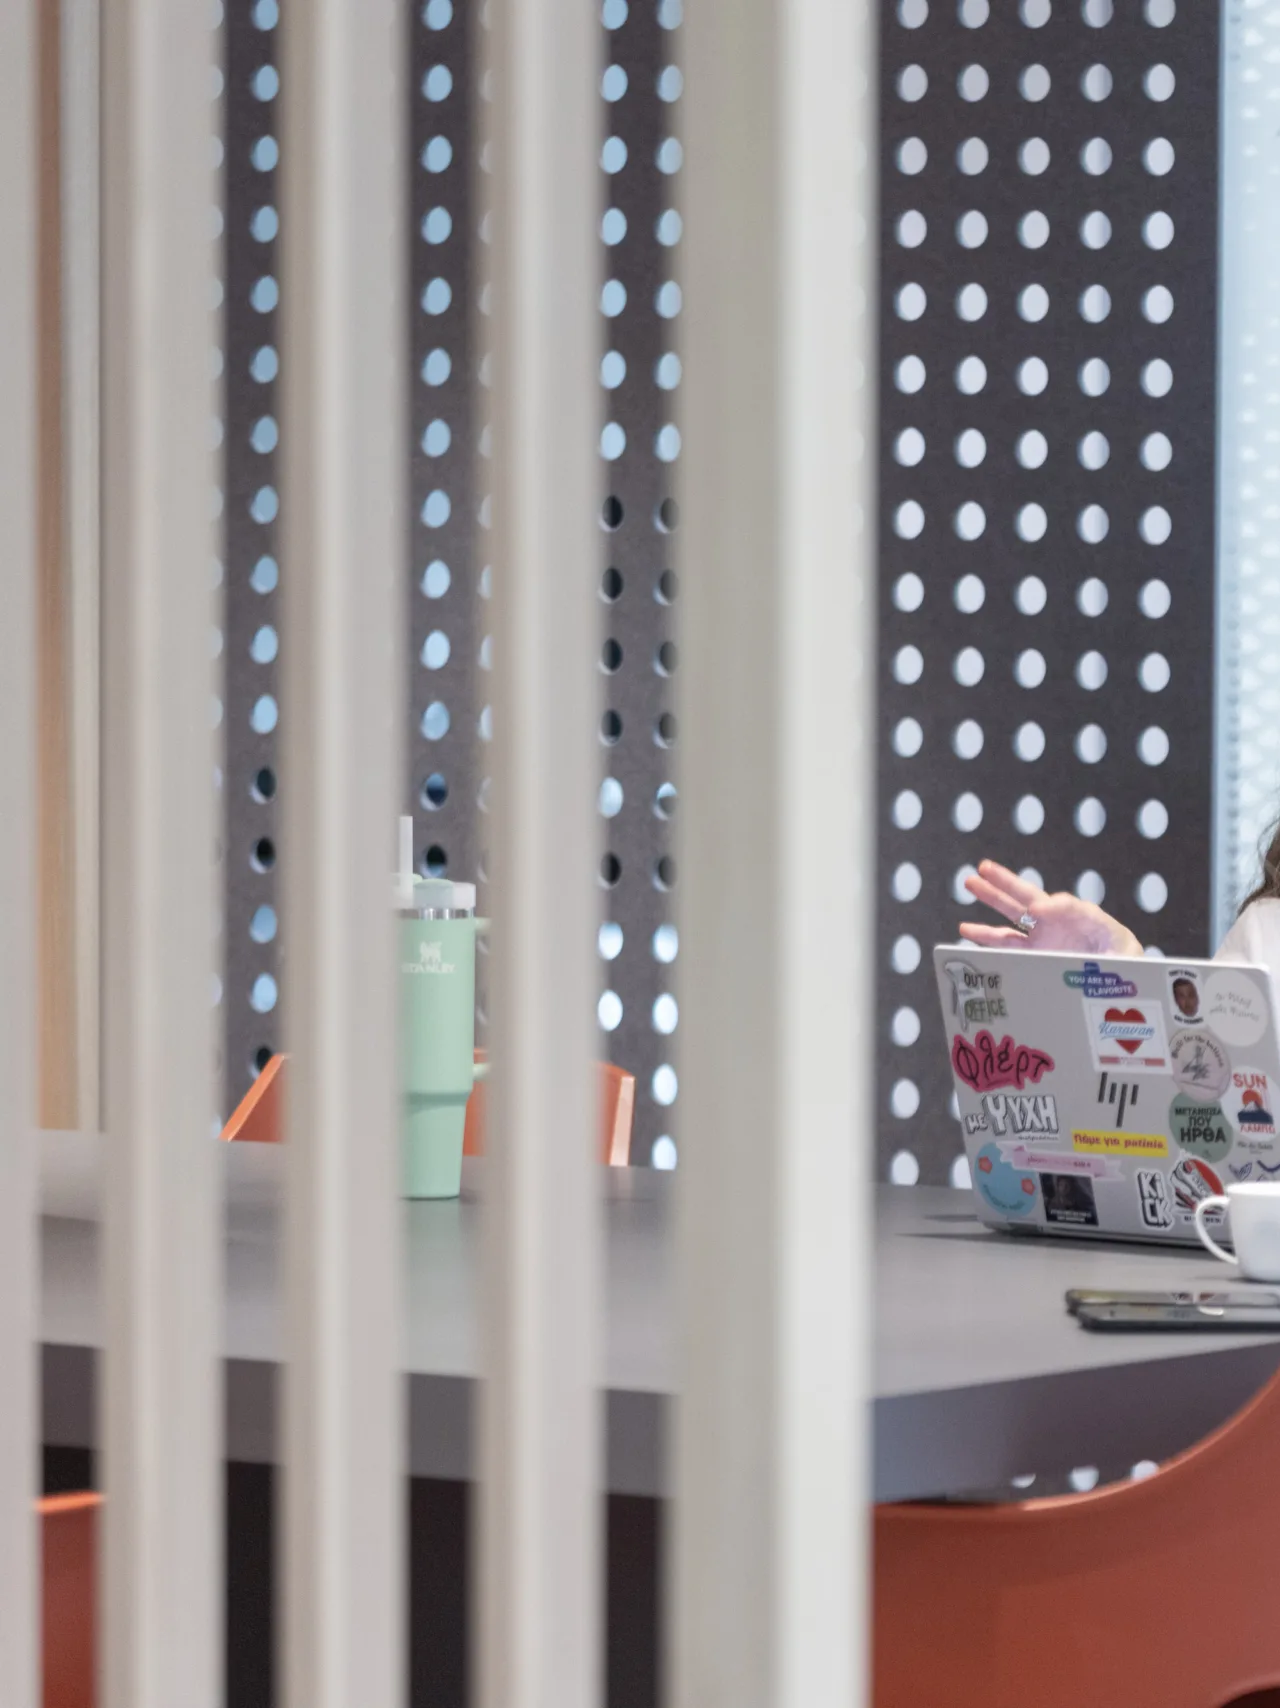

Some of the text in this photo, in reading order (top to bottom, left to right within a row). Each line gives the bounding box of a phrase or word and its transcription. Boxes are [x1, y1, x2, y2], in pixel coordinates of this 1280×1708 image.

[963, 973, 1000, 989] OUT OF
[1069, 975, 1117, 986] YOU ARE MY
[1087, 985, 1134, 996] FLAVORITE
[1232, 1072, 1267, 1089] SUN
